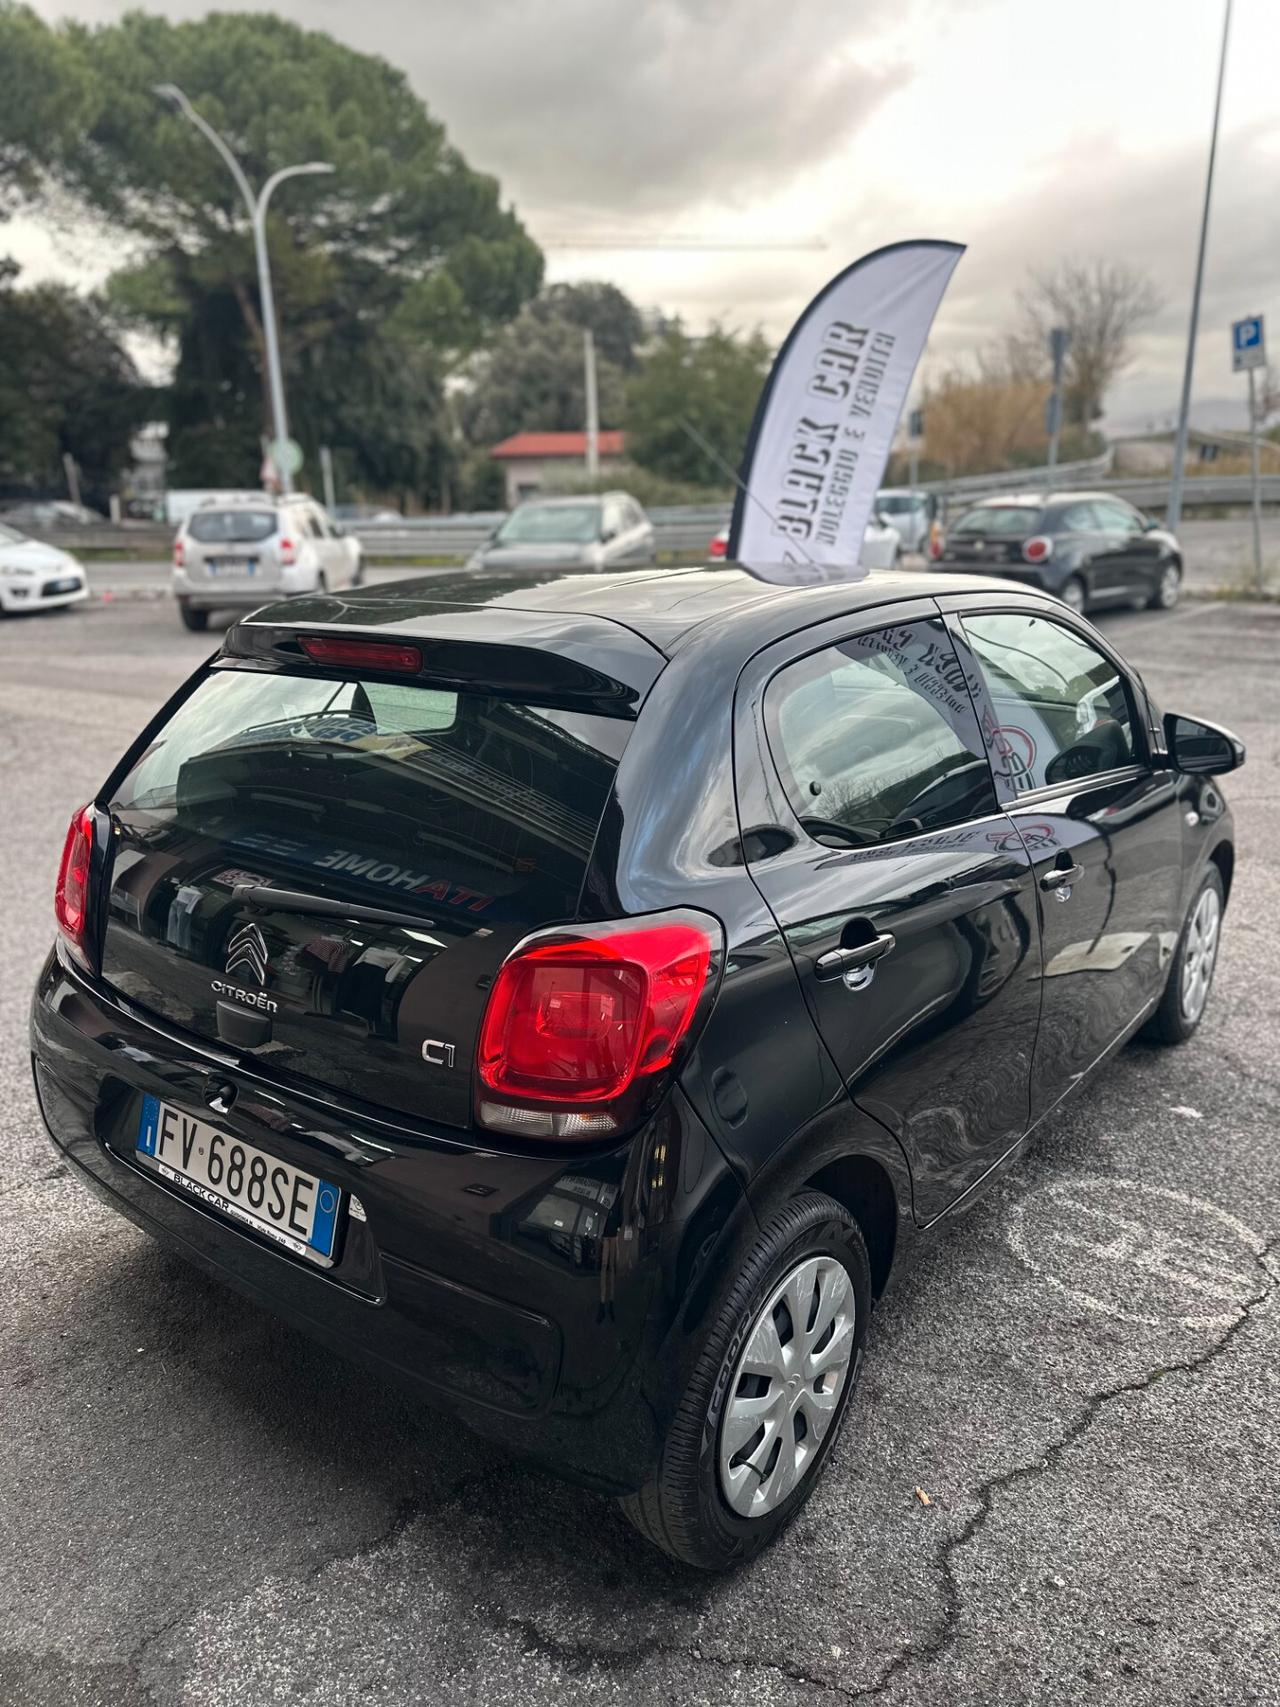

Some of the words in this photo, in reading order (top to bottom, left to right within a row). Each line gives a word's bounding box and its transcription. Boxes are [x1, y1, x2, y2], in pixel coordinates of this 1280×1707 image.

[848, 331, 896, 418] VENDITA
[774, 417, 839, 540] BLACK
[811, 321, 869, 399] CAR
[844, 427, 866, 440] E
[421, 1039, 456, 1068] C1
[173, 1173, 206, 1198] BLACK
[207, 1193, 230, 1212] CAR
